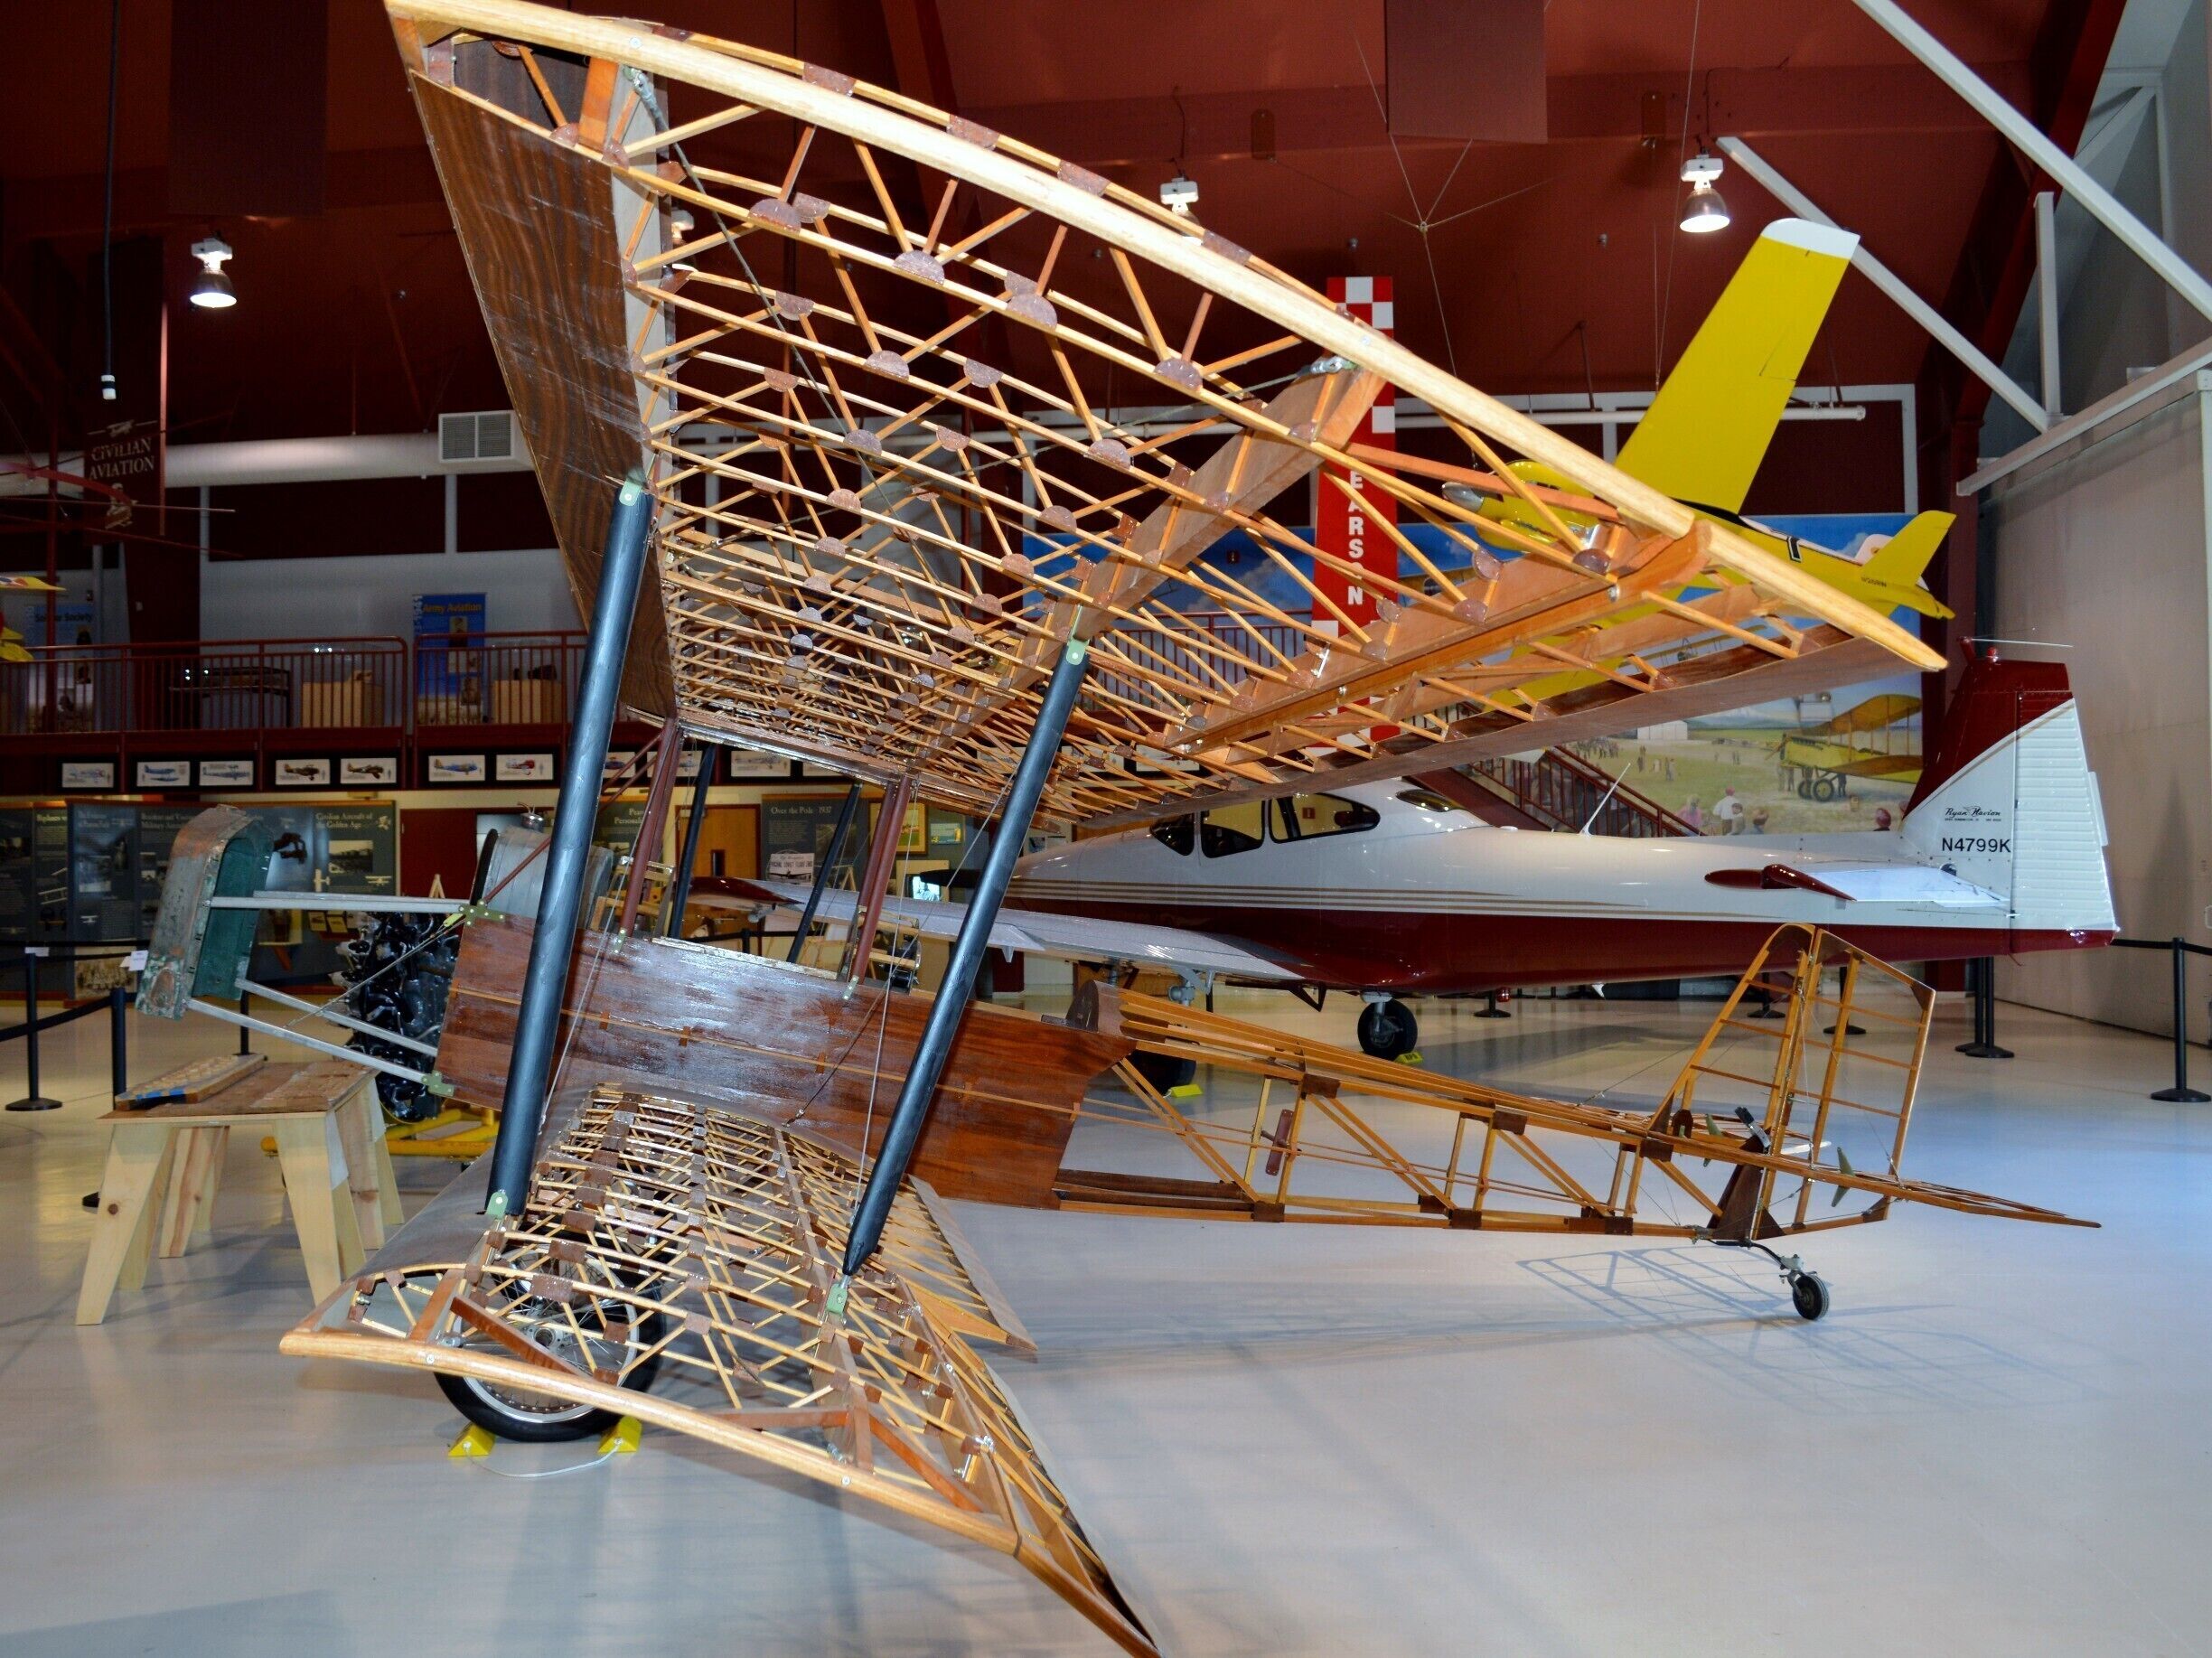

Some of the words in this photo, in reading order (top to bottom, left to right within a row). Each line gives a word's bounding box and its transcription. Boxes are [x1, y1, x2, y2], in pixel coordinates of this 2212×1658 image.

[90, 436, 152, 461] CIVILIAN
[89, 454, 155, 480] AVIATION
[423, 604, 445, 614] Army
[447, 603, 482, 612] Aviation
[771, 807, 786, 815] Over
[788, 807, 798, 815] the
[1945, 807, 1968, 818] Ryan
[1942, 837, 2011, 853] N4799K
